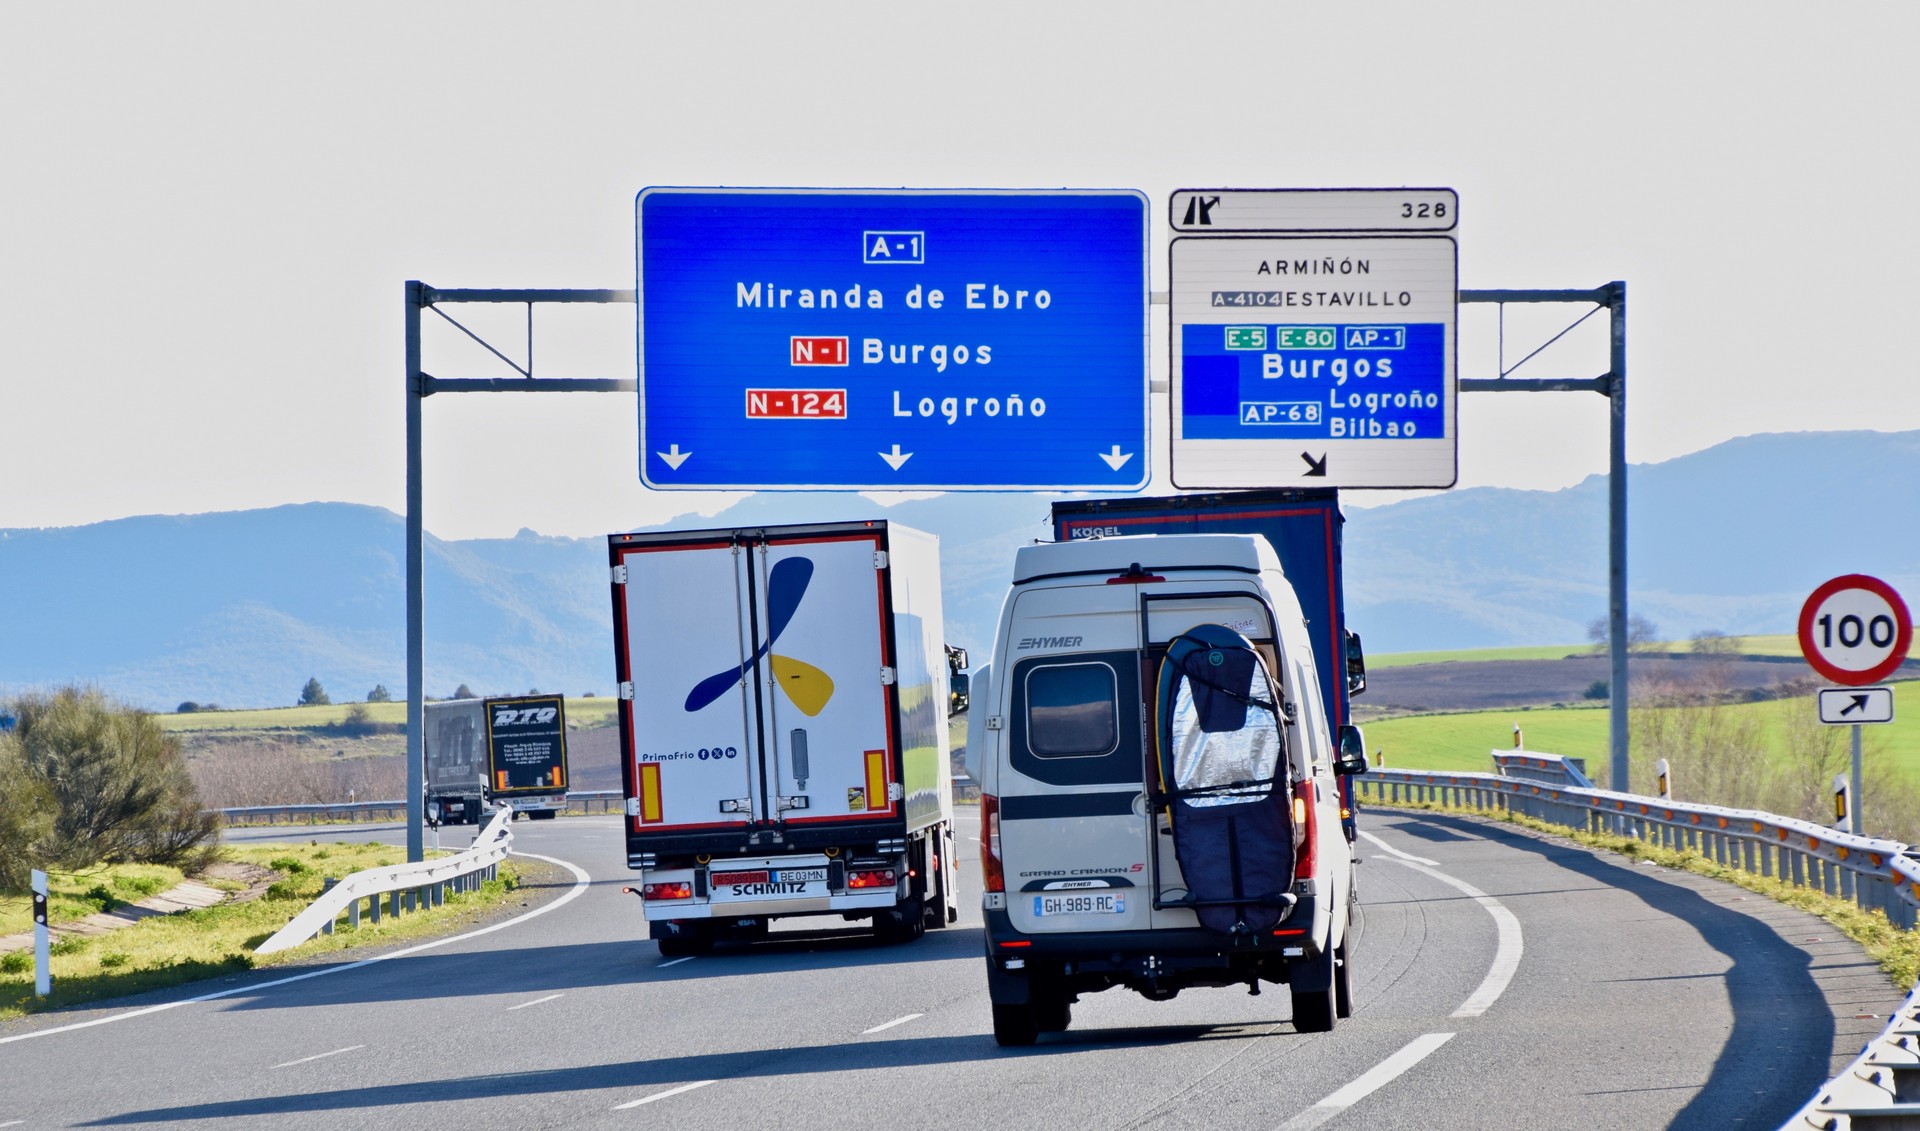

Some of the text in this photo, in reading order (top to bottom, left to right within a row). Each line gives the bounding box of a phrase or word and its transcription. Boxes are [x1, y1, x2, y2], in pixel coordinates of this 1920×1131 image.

[1401, 203, 1446, 219] 328
[870, 237, 919, 258] A-1
[1257, 257, 1370, 275] ARMIÑÓN
[737, 282, 1051, 309] Miranda de Ebro
[1213, 292, 1412, 307] A-4104 ESTAVILLO
[1228, 330, 1402, 346] E-5 E-80 AP-1
[863, 339, 992, 373] Burgos
[1263, 353, 1392, 386] Burgos
[750, 391, 1047, 425] N-124 Logroño
[1330, 389, 1438, 414] Logroño
[1244, 406, 1318, 422] AP-68
[1330, 417, 1416, 437] Bilbao
[1072, 526, 1122, 537] KÖGEL
[1818, 614, 1895, 648] 100
[1030, 636, 1083, 648] HYMER
[1070, 868, 1128, 876] CANYON
[1129, 863, 1145, 872] S
[732, 882, 806, 896] SCHMITZ
